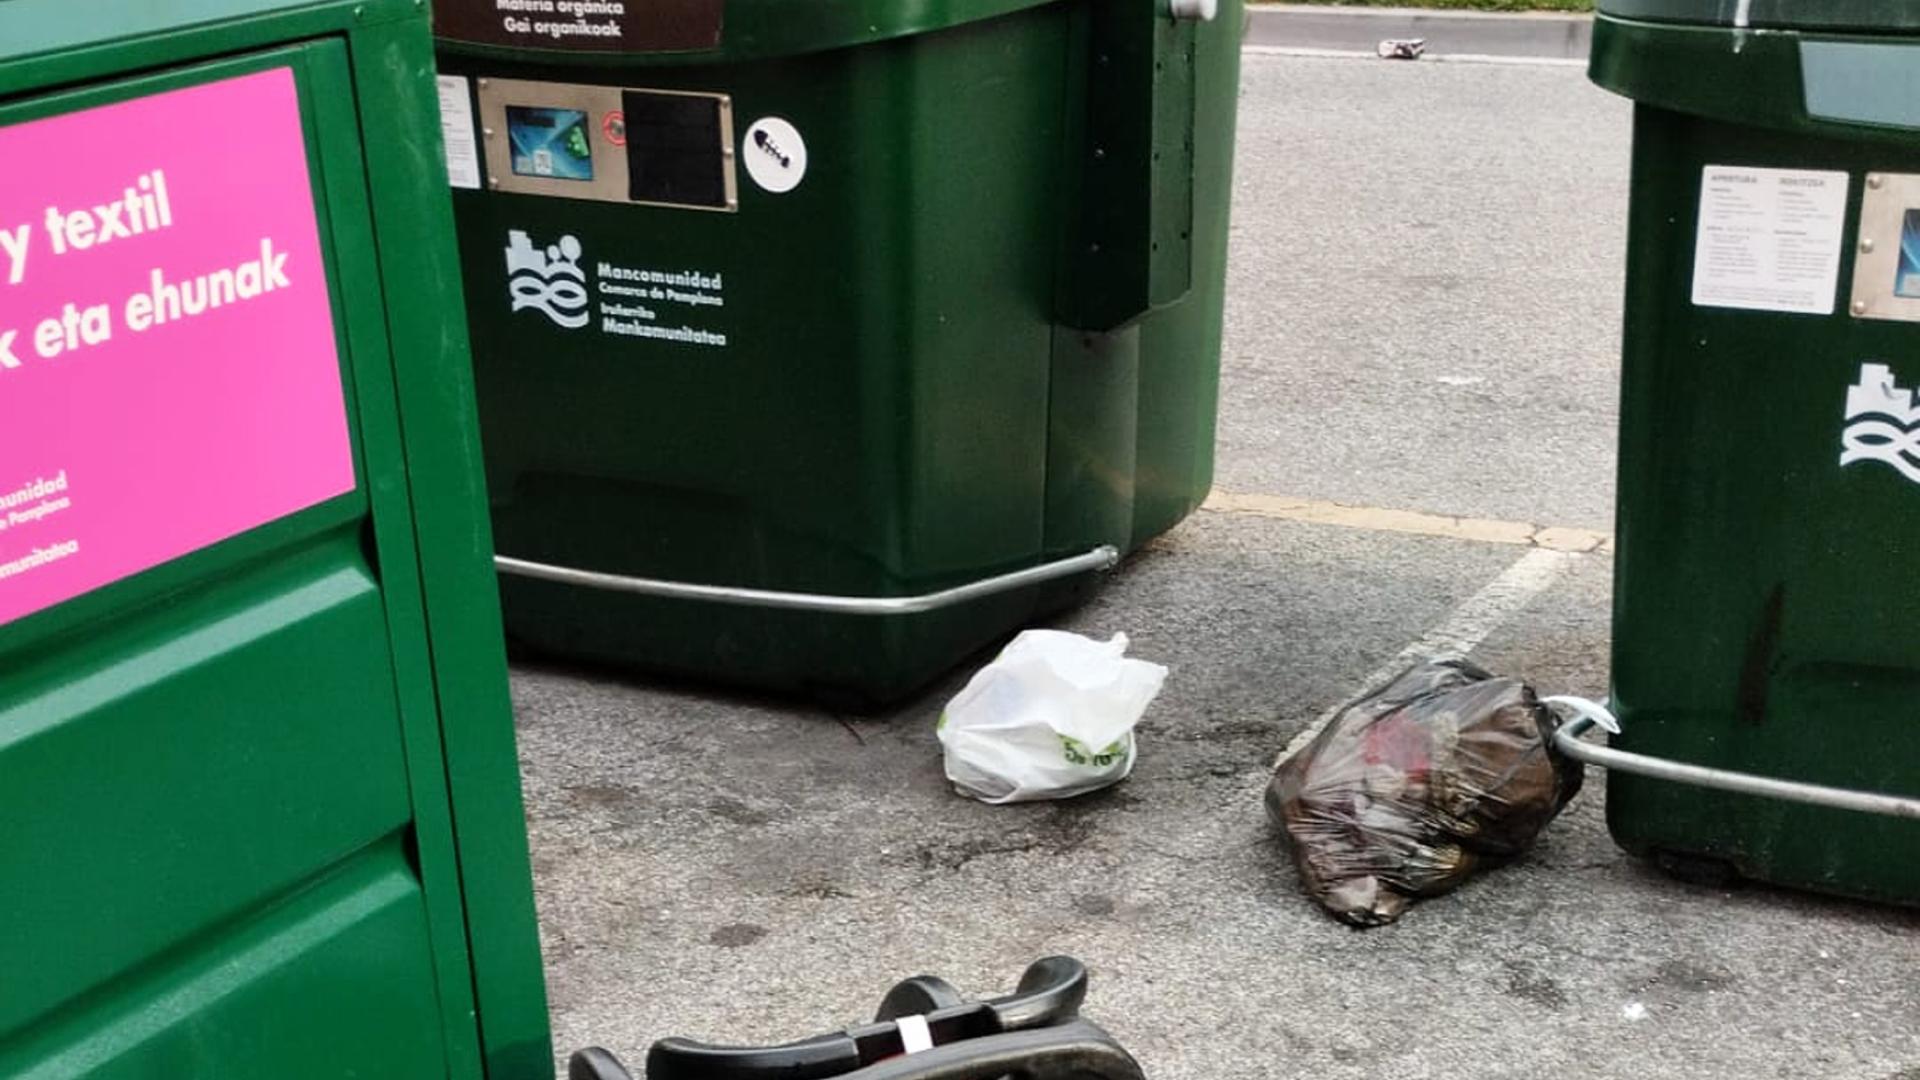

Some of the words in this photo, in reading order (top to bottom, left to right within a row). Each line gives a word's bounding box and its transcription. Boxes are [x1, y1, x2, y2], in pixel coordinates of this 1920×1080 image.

[557, 0, 625, 17] orgánica
[504, 16, 531, 32] Gai
[534, 19, 622, 38] organikoak
[0, 224, 31, 286] y
[44, 169, 172, 256] textil
[597, 262, 723, 290] Mancomunidad
[34, 302, 111, 358] eta
[125, 237, 291, 332] ehunak
[598, 281, 648, 298] Comarca
[650, 286, 665, 300] de
[665, 288, 724, 307] Pamplona
[602, 316, 727, 347] Mankomunitatea
[8, 496, 71, 526] Pamplona
